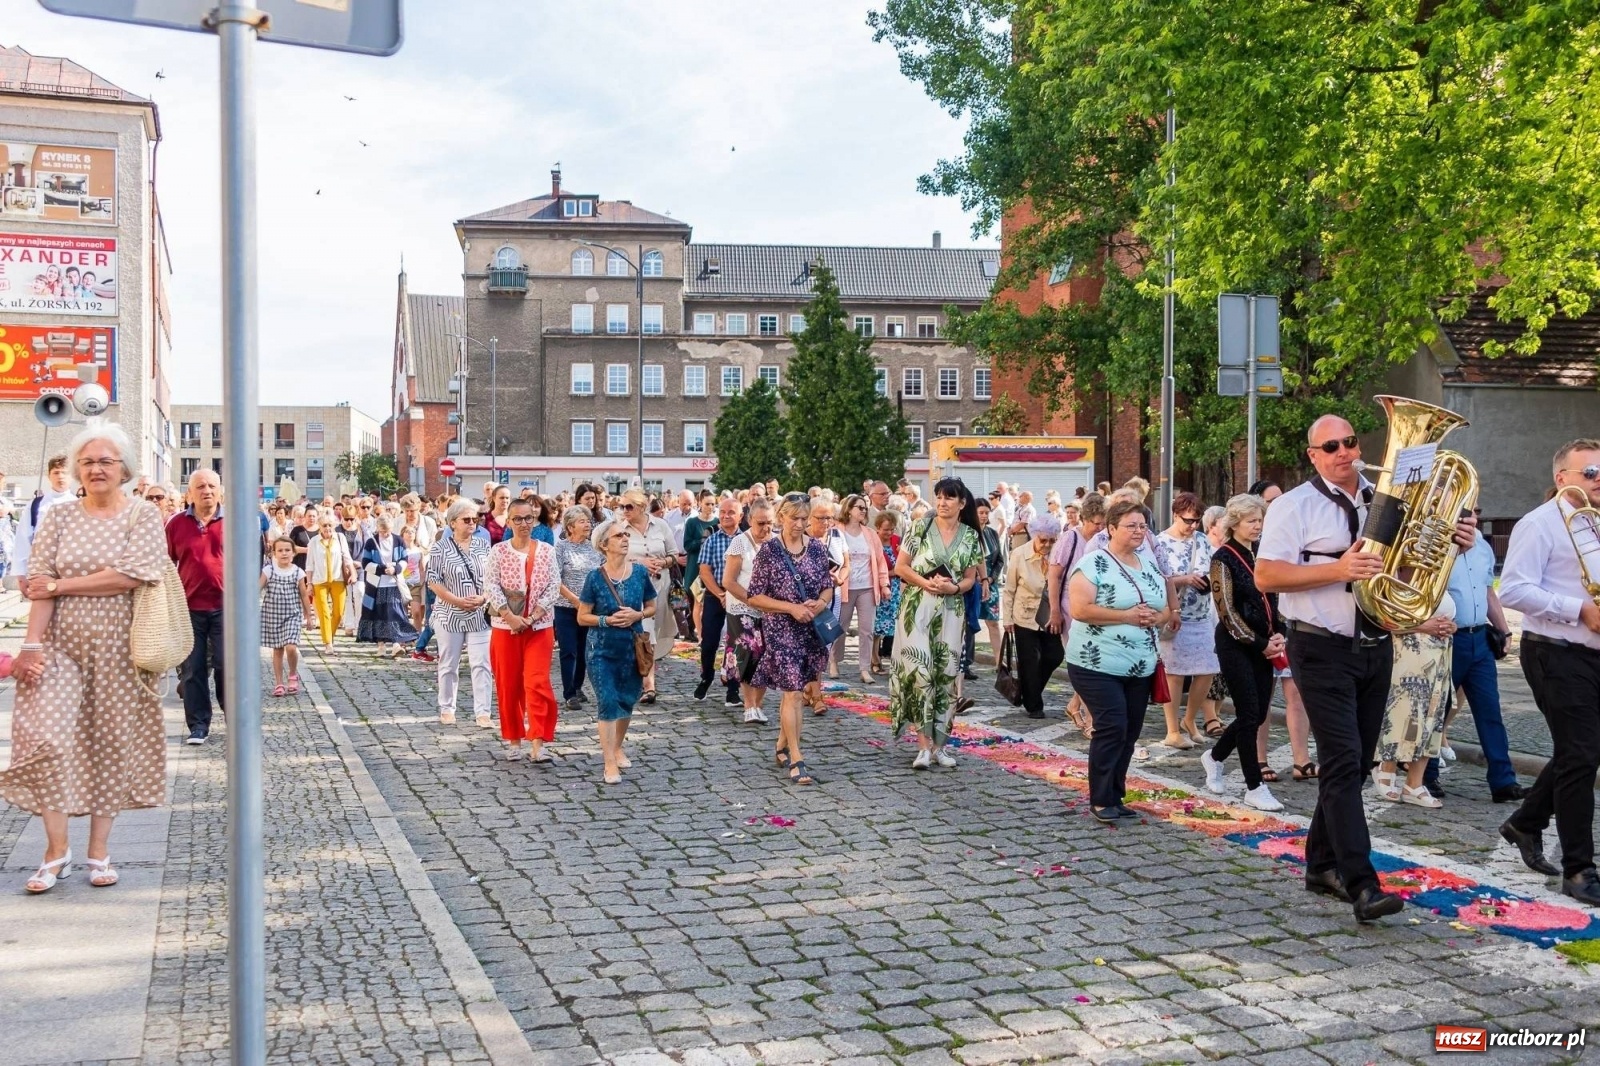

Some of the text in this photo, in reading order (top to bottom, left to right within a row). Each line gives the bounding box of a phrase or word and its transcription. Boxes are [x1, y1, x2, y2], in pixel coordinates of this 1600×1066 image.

[41, 151, 91, 164] RYNEK 8
[26, 237, 74, 248] najlepszych
[75, 241, 105, 249] cenach
[1, 248, 108, 266] XANDER
[11, 298, 25, 308] ul.
[28, 297, 81, 310] ŻORSKA
[85, 301, 103, 311] 192
